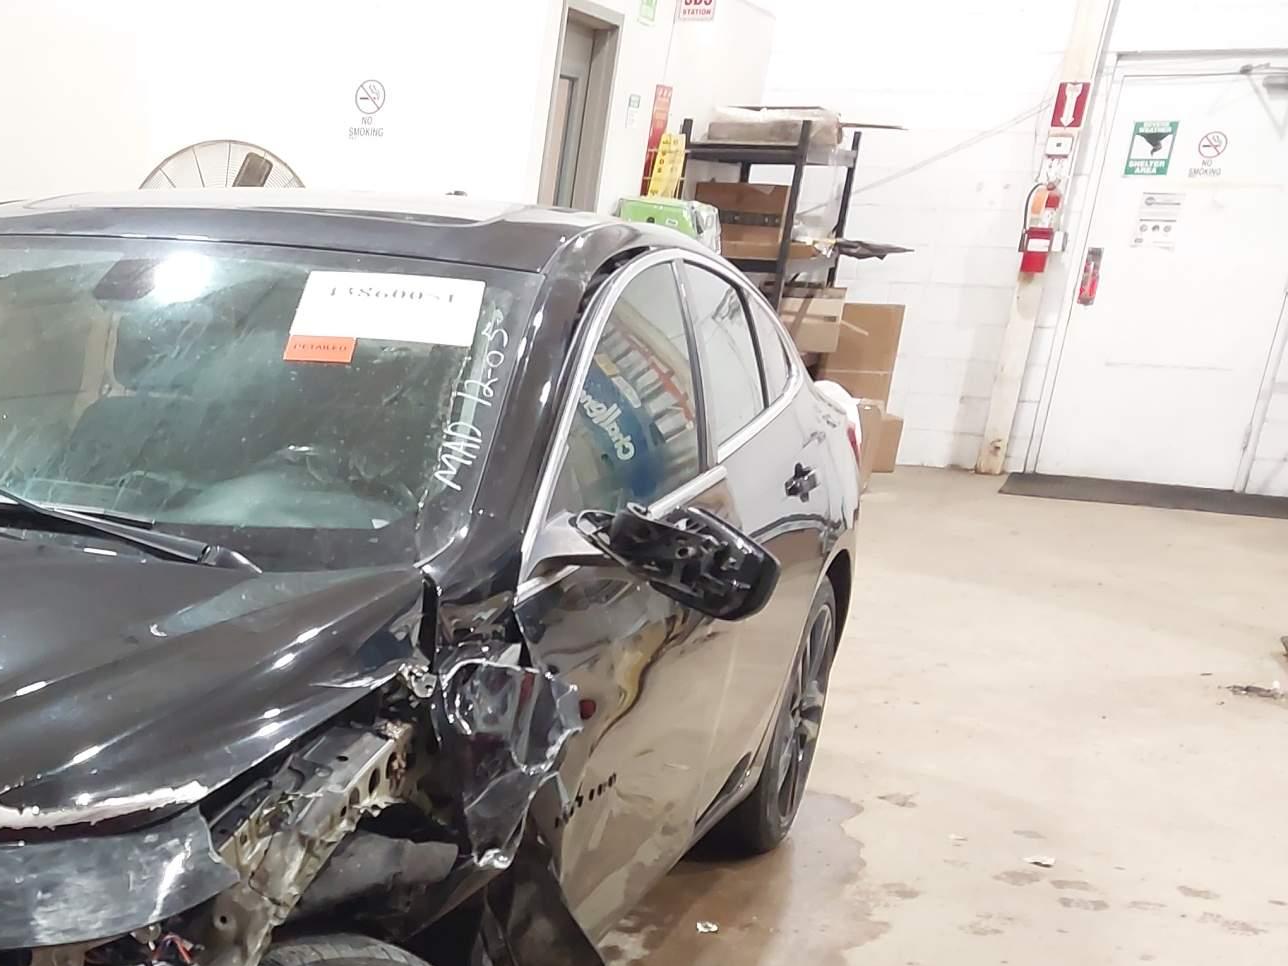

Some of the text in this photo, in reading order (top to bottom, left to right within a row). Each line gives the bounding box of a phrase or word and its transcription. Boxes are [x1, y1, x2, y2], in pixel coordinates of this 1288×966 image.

[361, 116, 373, 125] NO
[348, 127, 384, 137] SMOKING
[1128, 160, 1166, 168] SHELTER
[1201, 159, 1213, 168] NO
[1188, 168, 1222, 177] SMOKING
